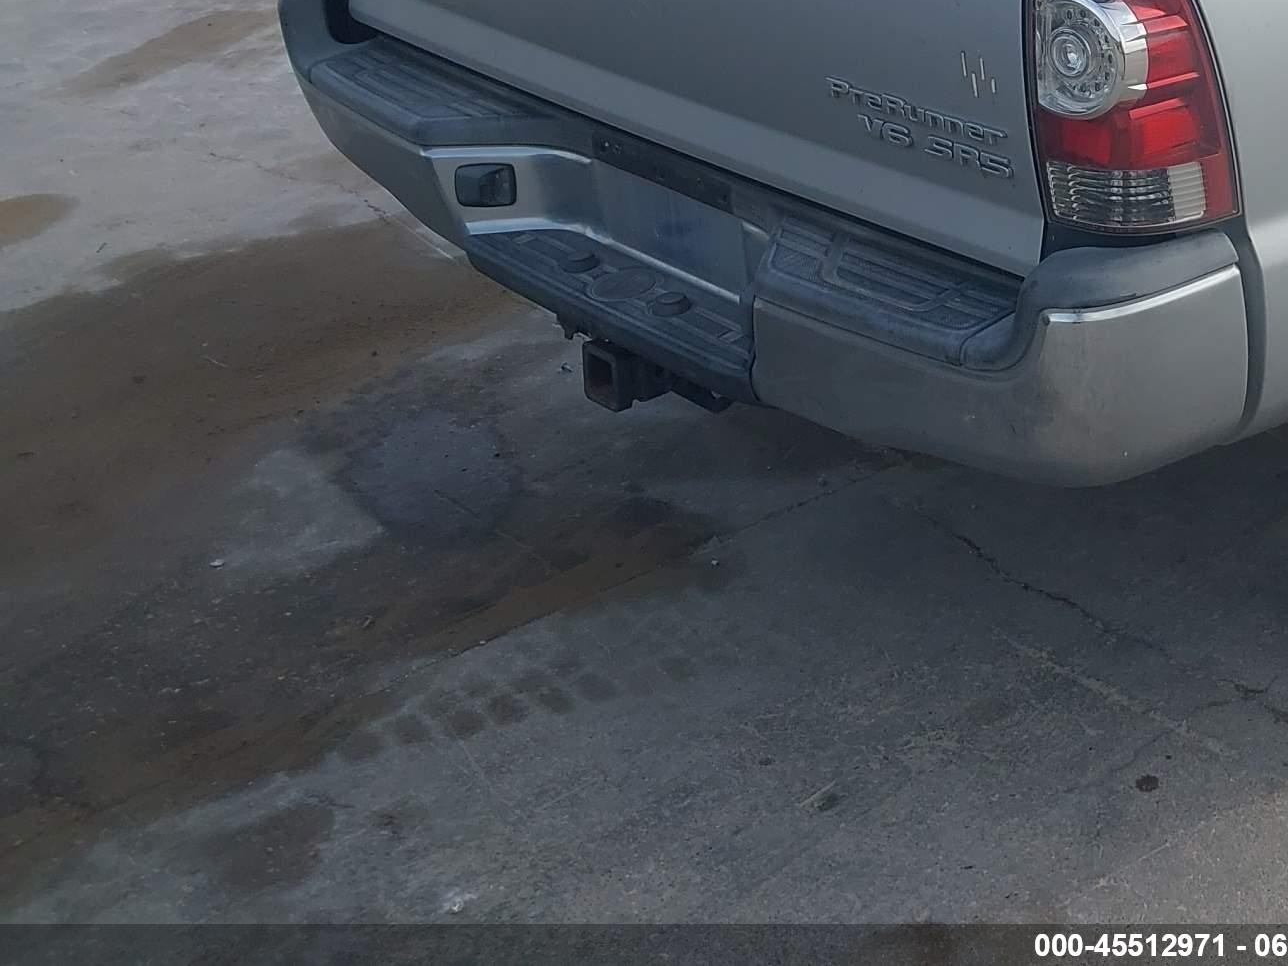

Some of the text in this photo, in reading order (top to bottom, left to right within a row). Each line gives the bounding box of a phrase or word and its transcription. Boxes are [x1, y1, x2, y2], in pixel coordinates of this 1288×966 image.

[826, 75, 1008, 145] PreRunner
[857, 114, 1015, 178] V6 SR5
